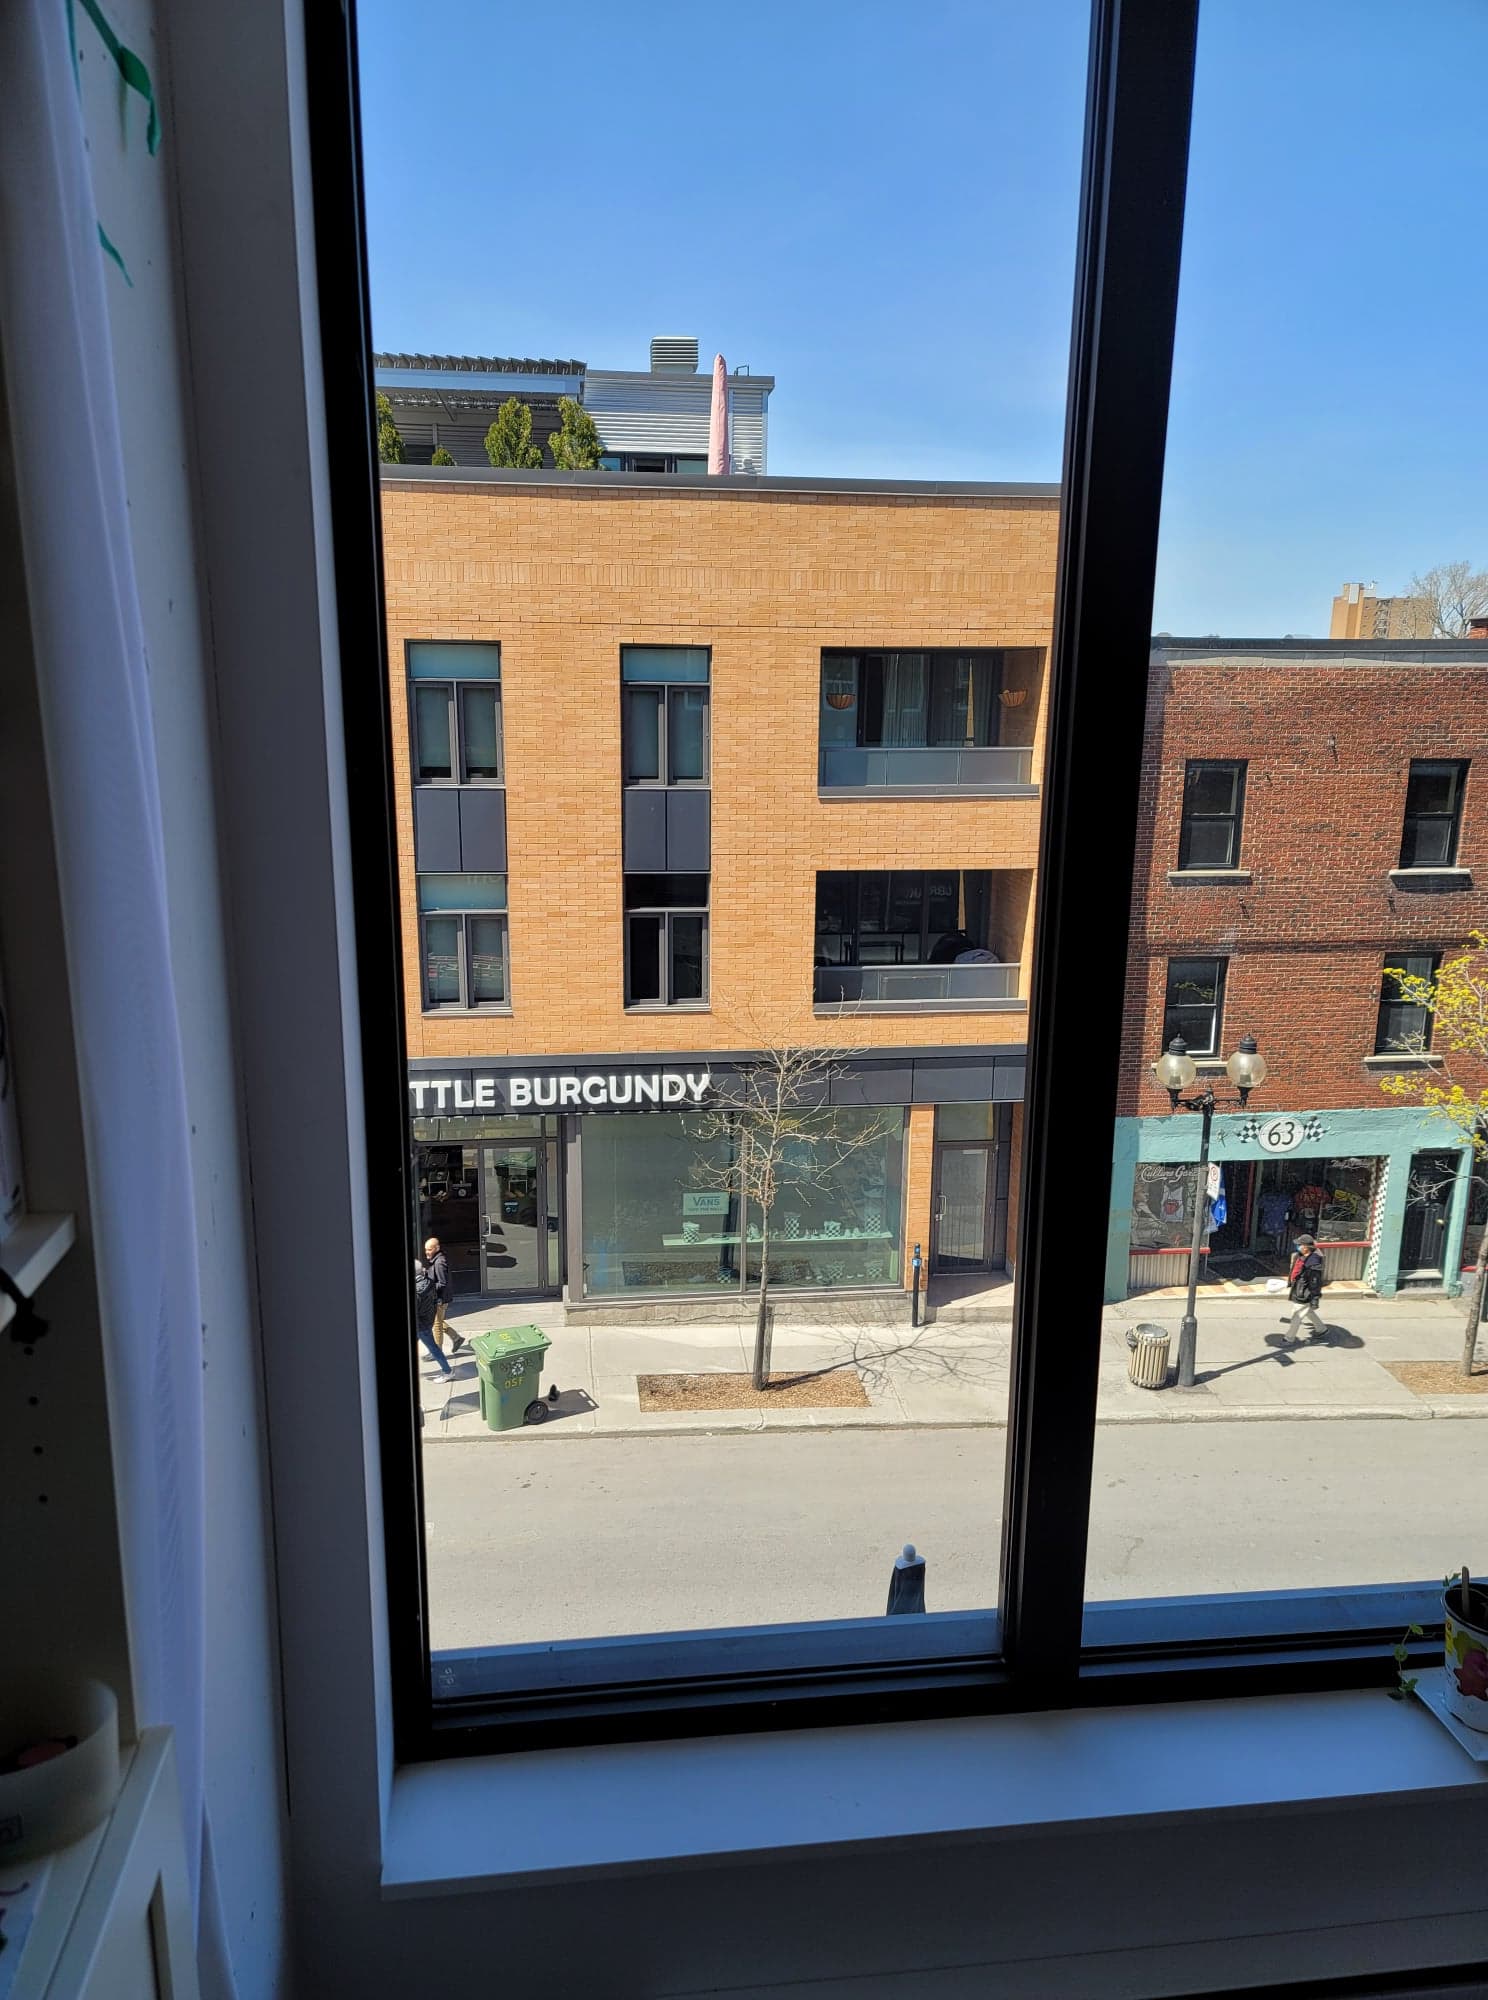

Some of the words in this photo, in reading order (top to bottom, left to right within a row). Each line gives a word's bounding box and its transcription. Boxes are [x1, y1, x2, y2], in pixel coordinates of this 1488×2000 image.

[509, 1074, 710, 1107] BURGUNDY
[1268, 1121, 1295, 1146] 63
[692, 1195, 721, 1206] VANS
